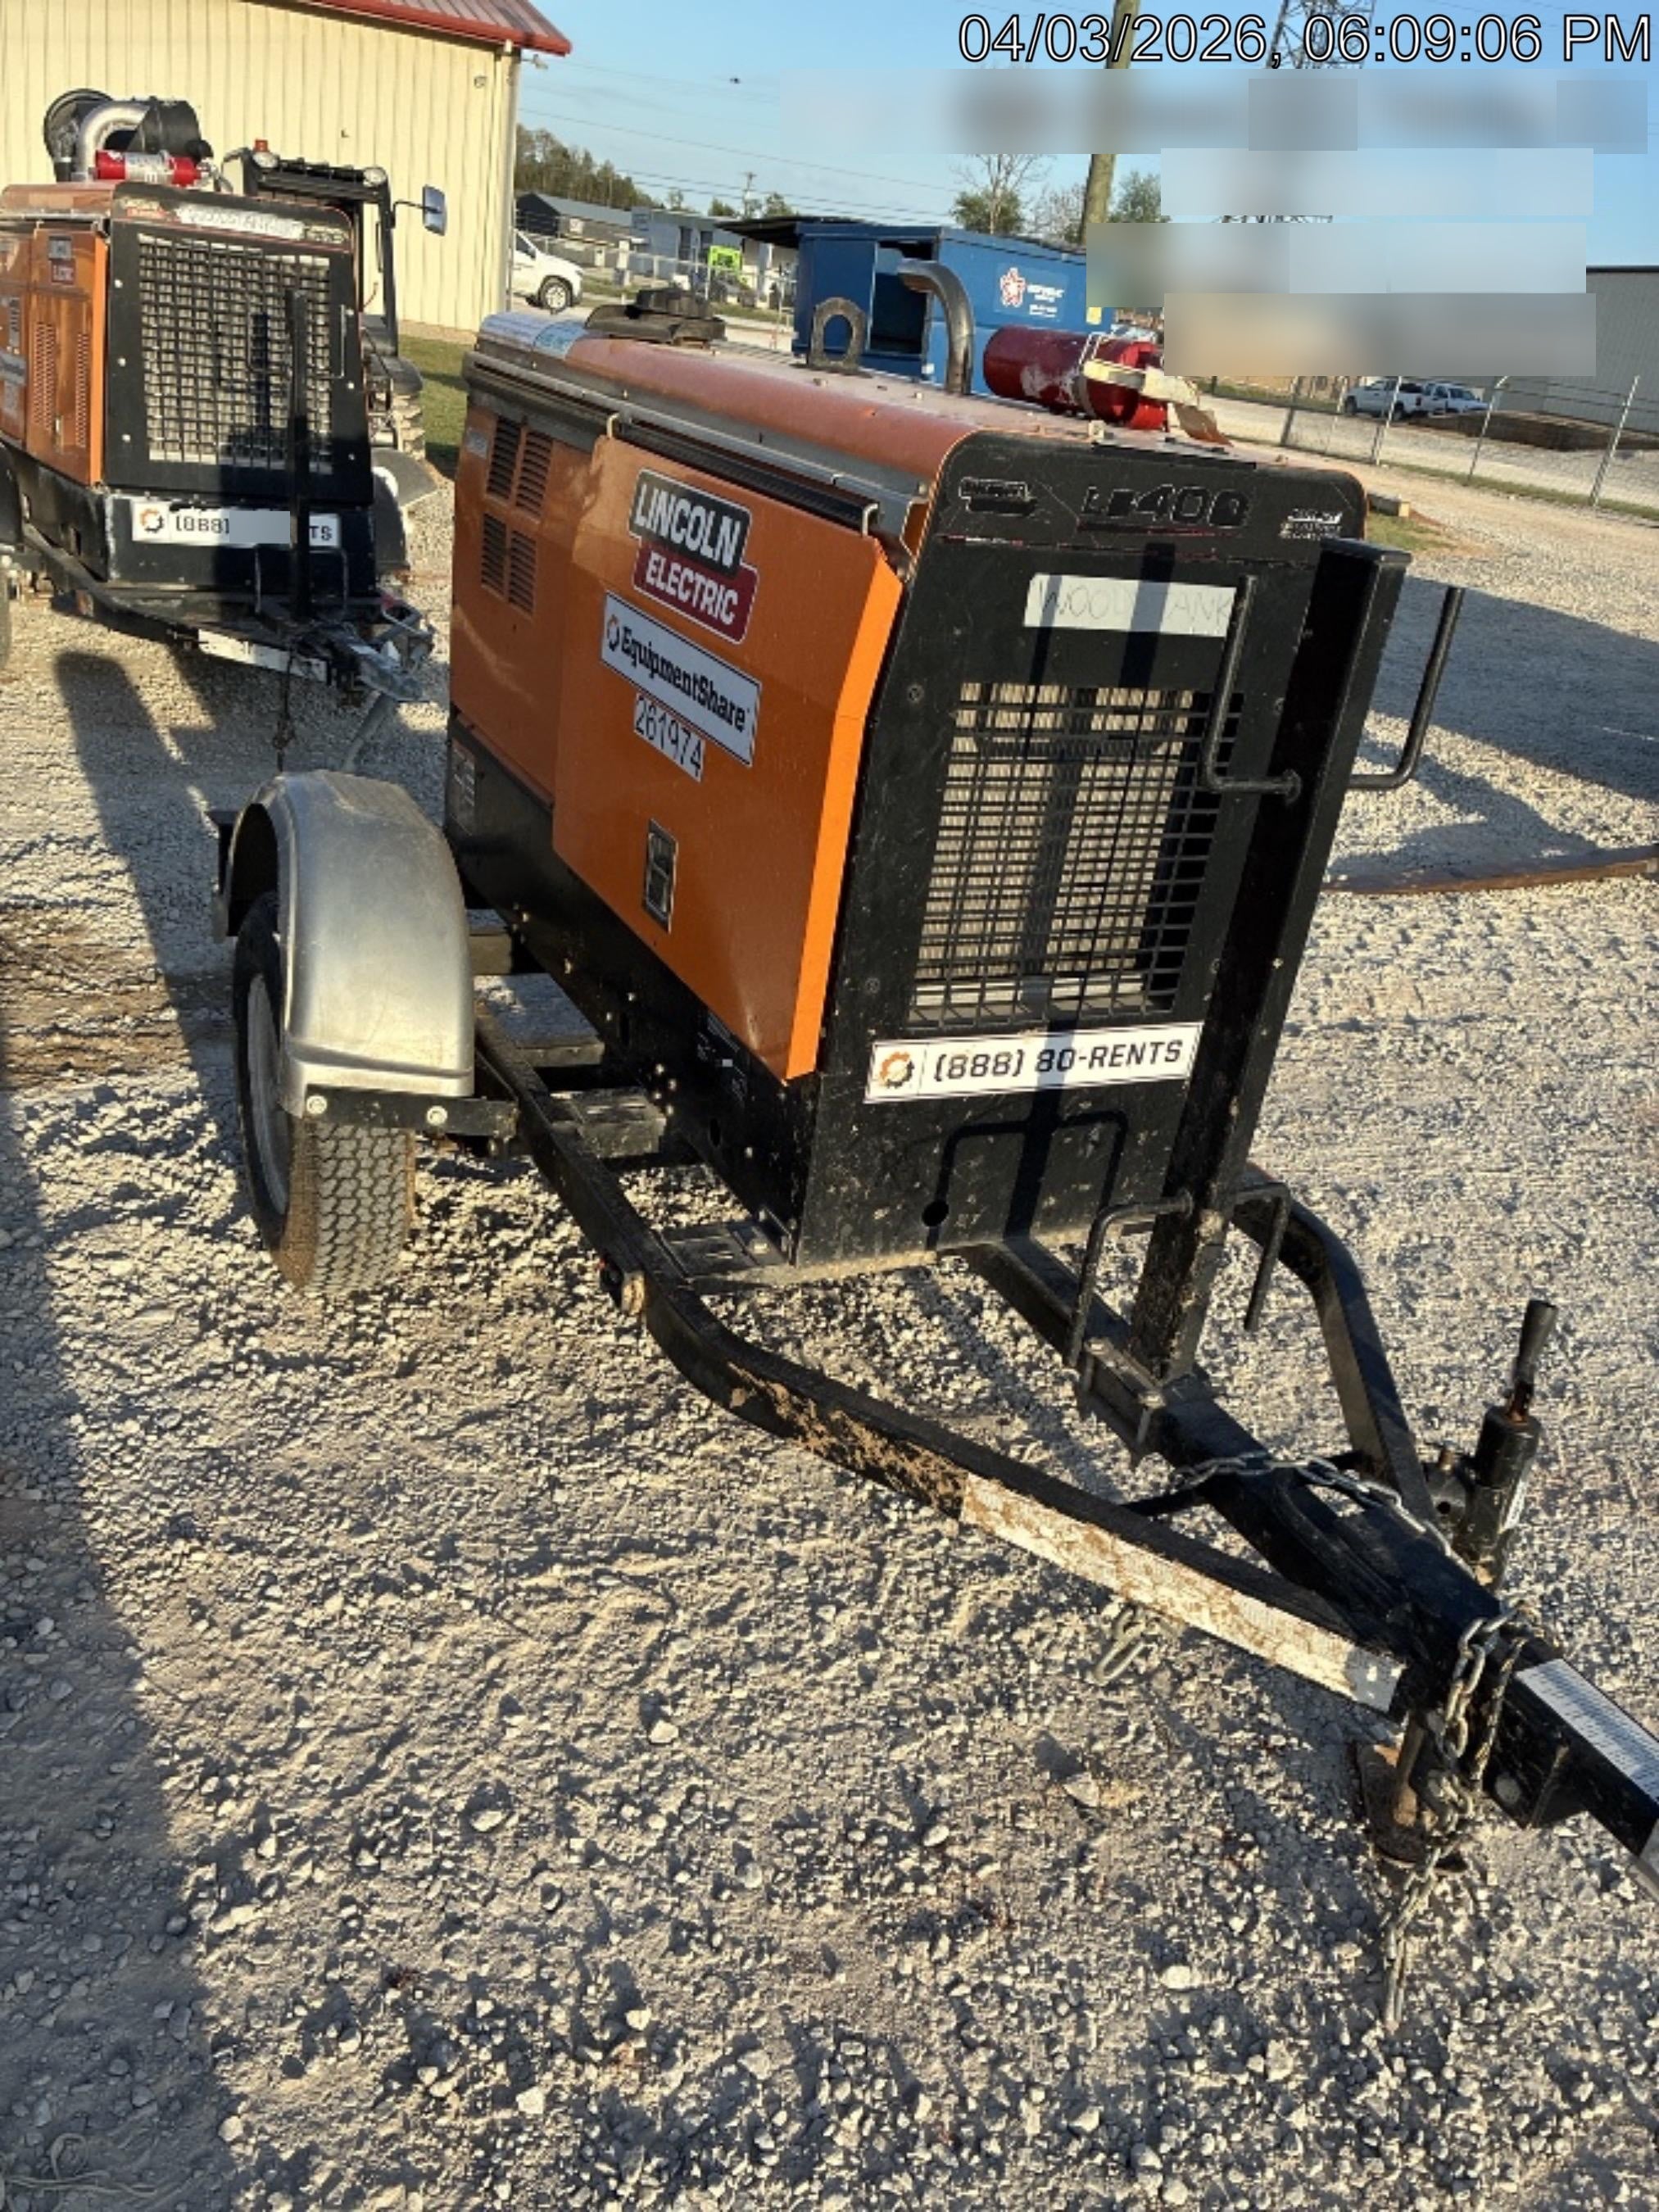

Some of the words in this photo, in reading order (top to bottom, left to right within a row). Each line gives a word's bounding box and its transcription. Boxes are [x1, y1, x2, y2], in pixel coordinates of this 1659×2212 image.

[633, 483, 741, 569] LINCOLN
[646, 551, 737, 625] ELECTRIC
[620, 626, 747, 732] EquipmentShare
[635, 695, 703, 777] 261974
[934, 1049, 1024, 1082] (888)
[1035, 1039, 1184, 1073] 80-RENTS
